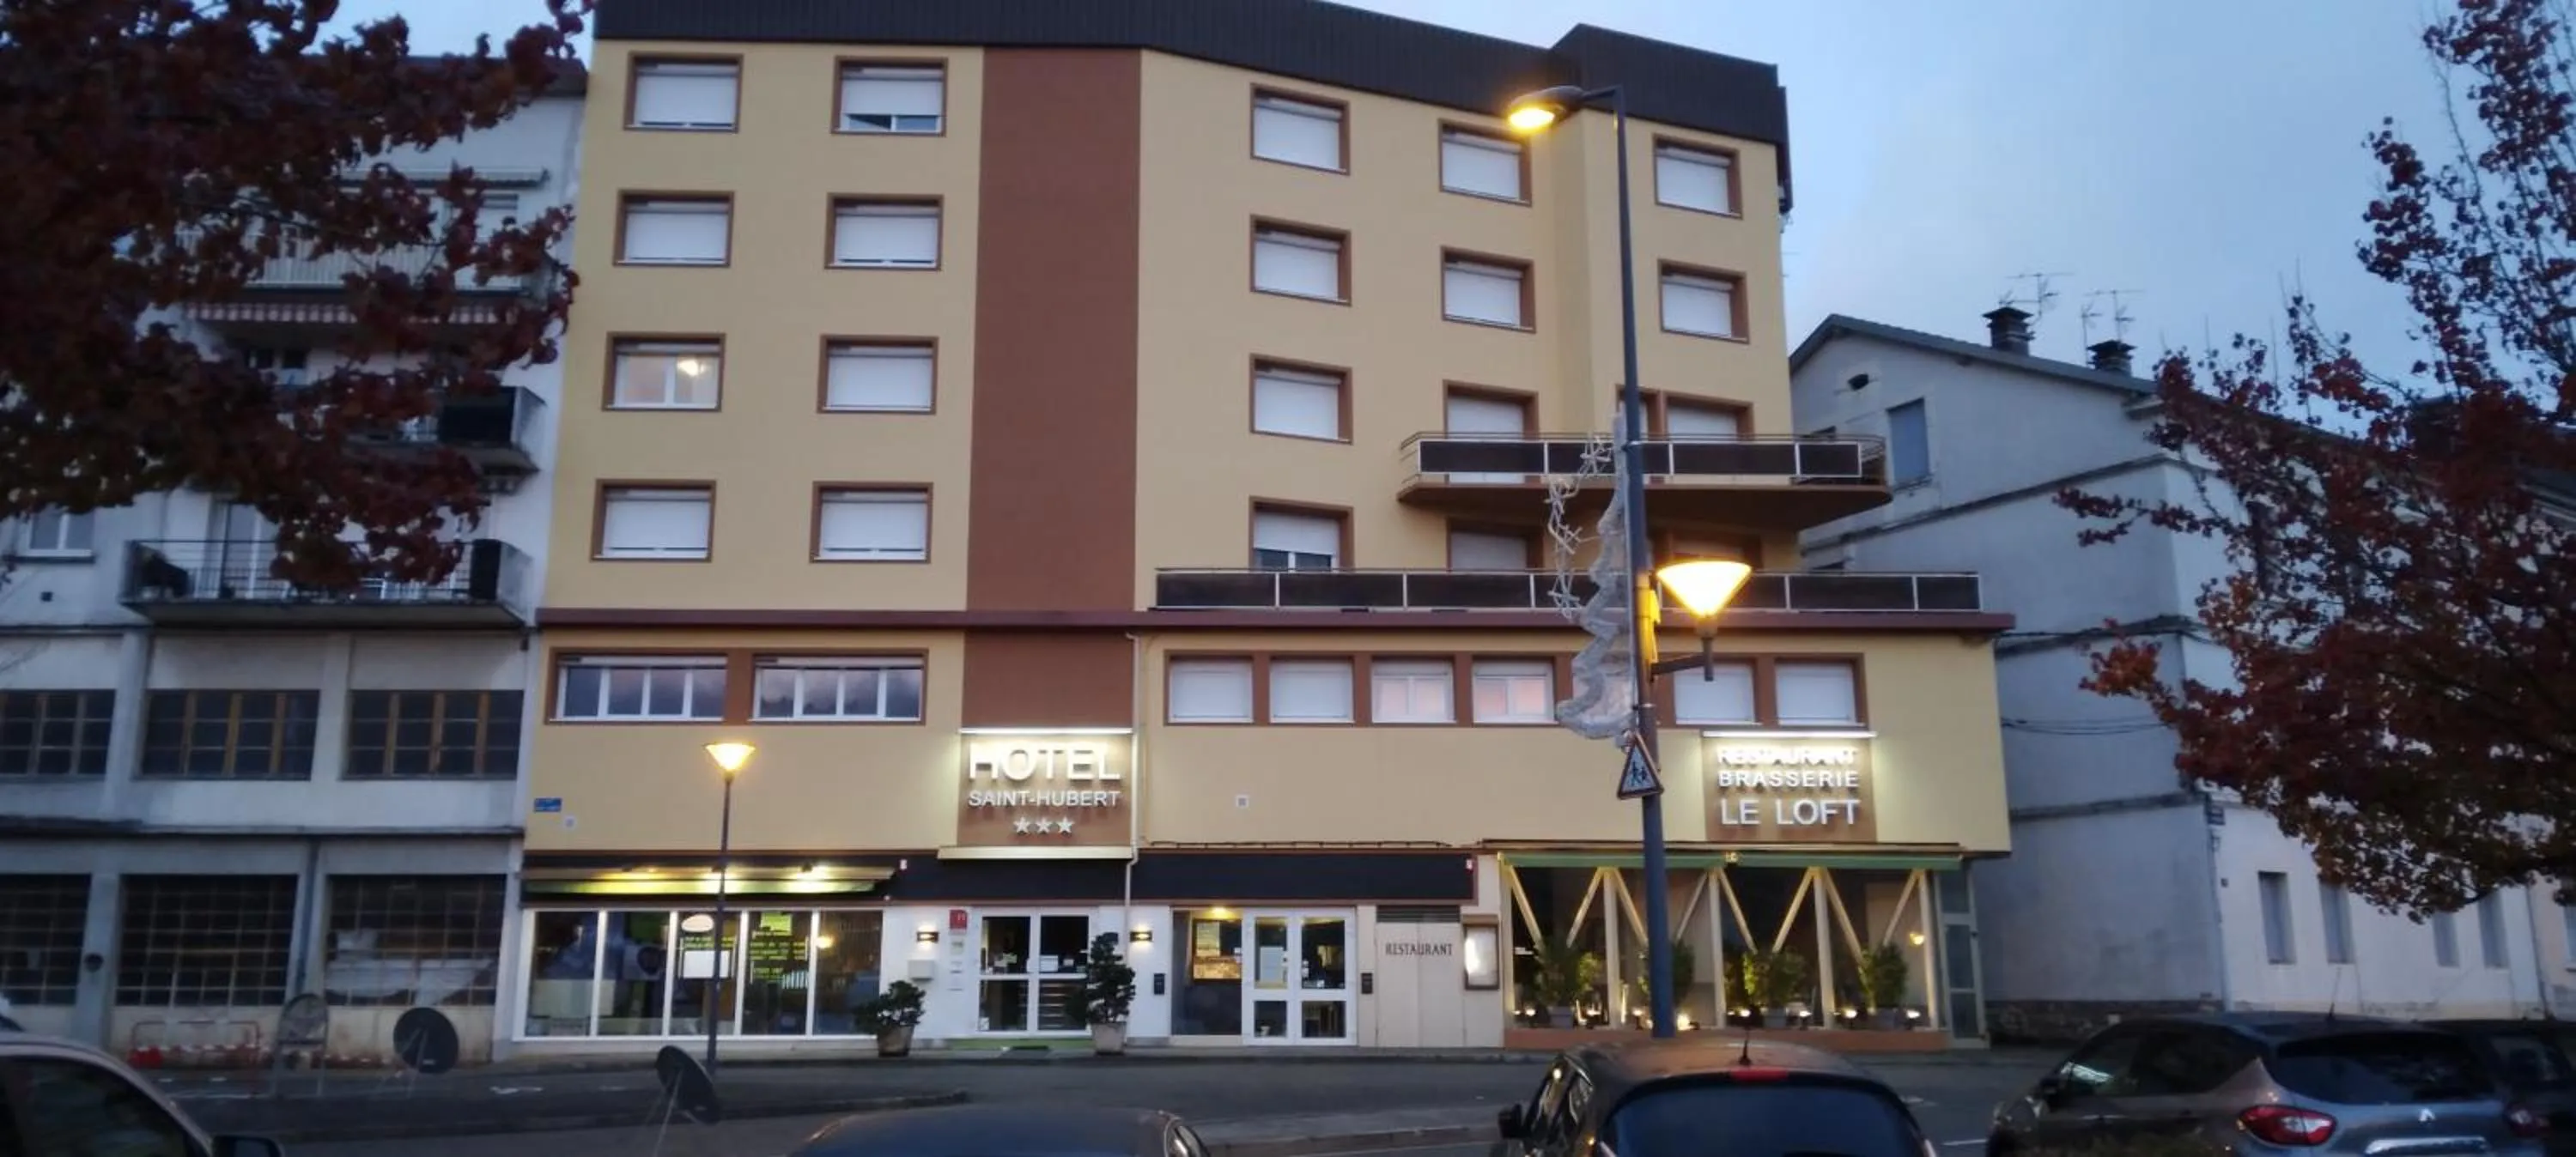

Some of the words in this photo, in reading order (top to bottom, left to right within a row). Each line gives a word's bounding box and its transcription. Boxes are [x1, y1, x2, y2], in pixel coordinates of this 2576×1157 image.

[969, 743, 1121, 780] HOTEL
[1718, 747, 1859, 766] RESTAURANT
[1718, 770, 1859, 787] BRASSERIE
[968, 790, 1121, 807] SAINT-HUBERT
[1721, 798, 1761, 825] LE
[1776, 798, 1861, 825] LOFT
[1385, 942, 1453, 955] RESTAURANT
